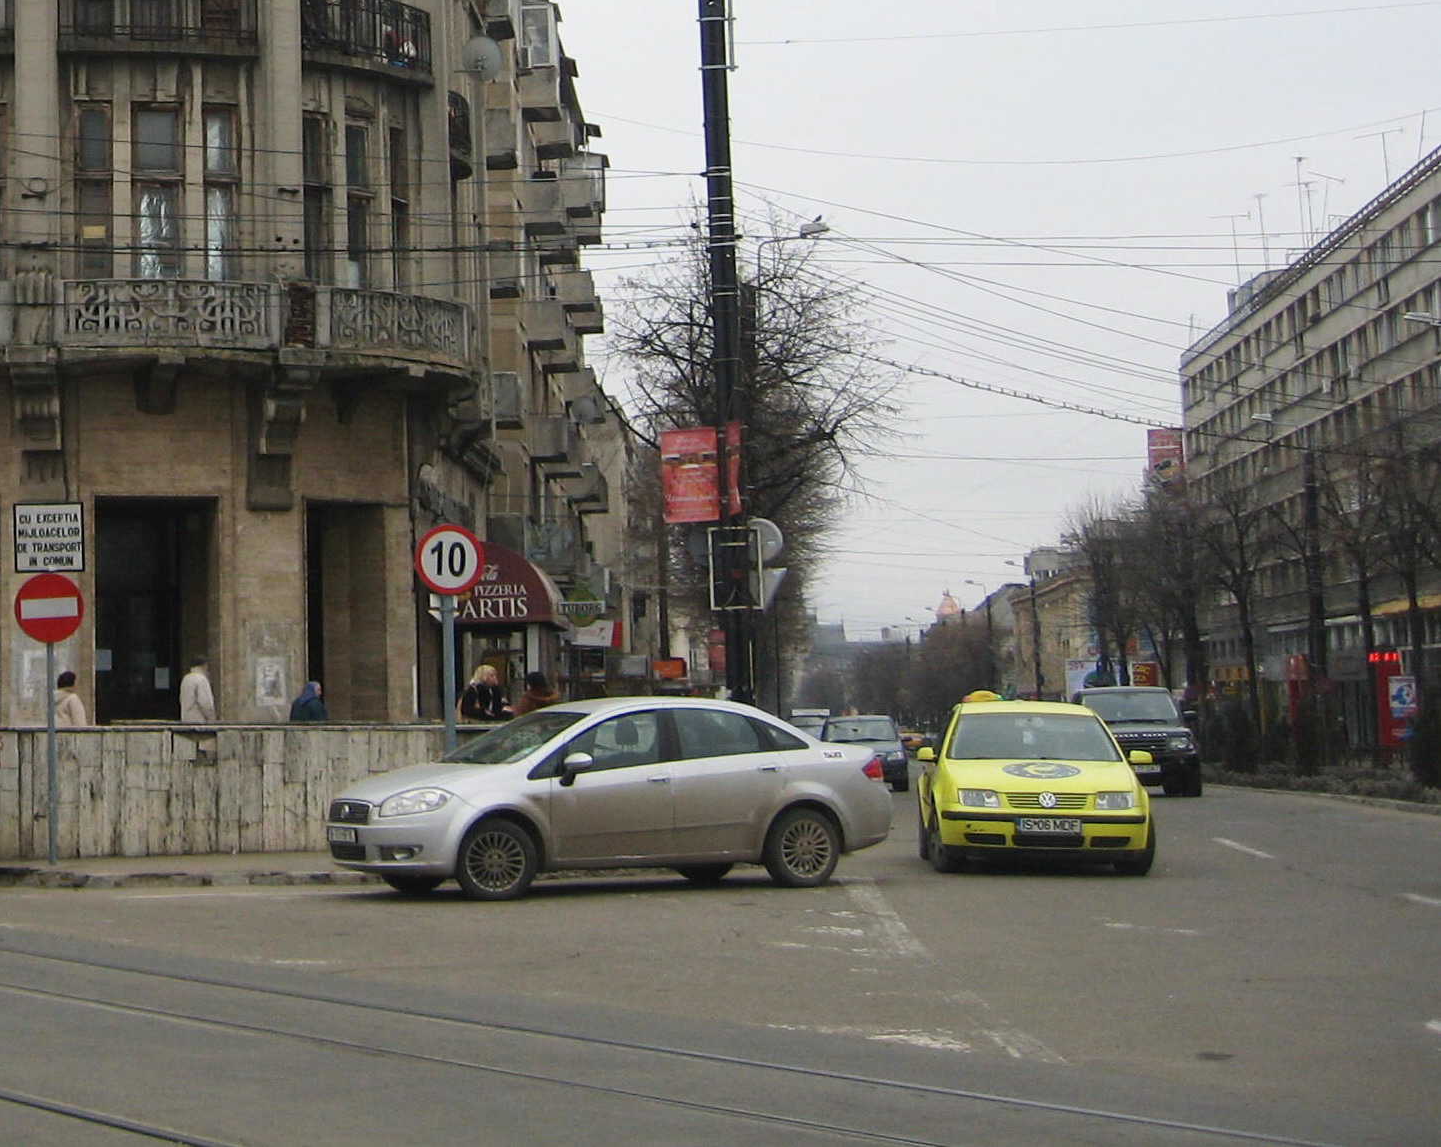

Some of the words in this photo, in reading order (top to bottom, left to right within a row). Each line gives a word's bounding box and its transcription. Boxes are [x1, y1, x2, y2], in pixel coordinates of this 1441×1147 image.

[19, 515, 31, 524] CU
[36, 513, 79, 523] EXCEPTIA
[18, 527, 80, 538] MIJLOACELOR
[17, 543, 27, 553] DE
[32, 541, 82, 552] TRANSPORT
[29, 557, 37, 566] IN
[43, 556, 74, 566] COMUN
[431, 540, 466, 577] 10
[474, 584, 527, 596] PIZZERIA
[462, 597, 528, 619] ARTIS
